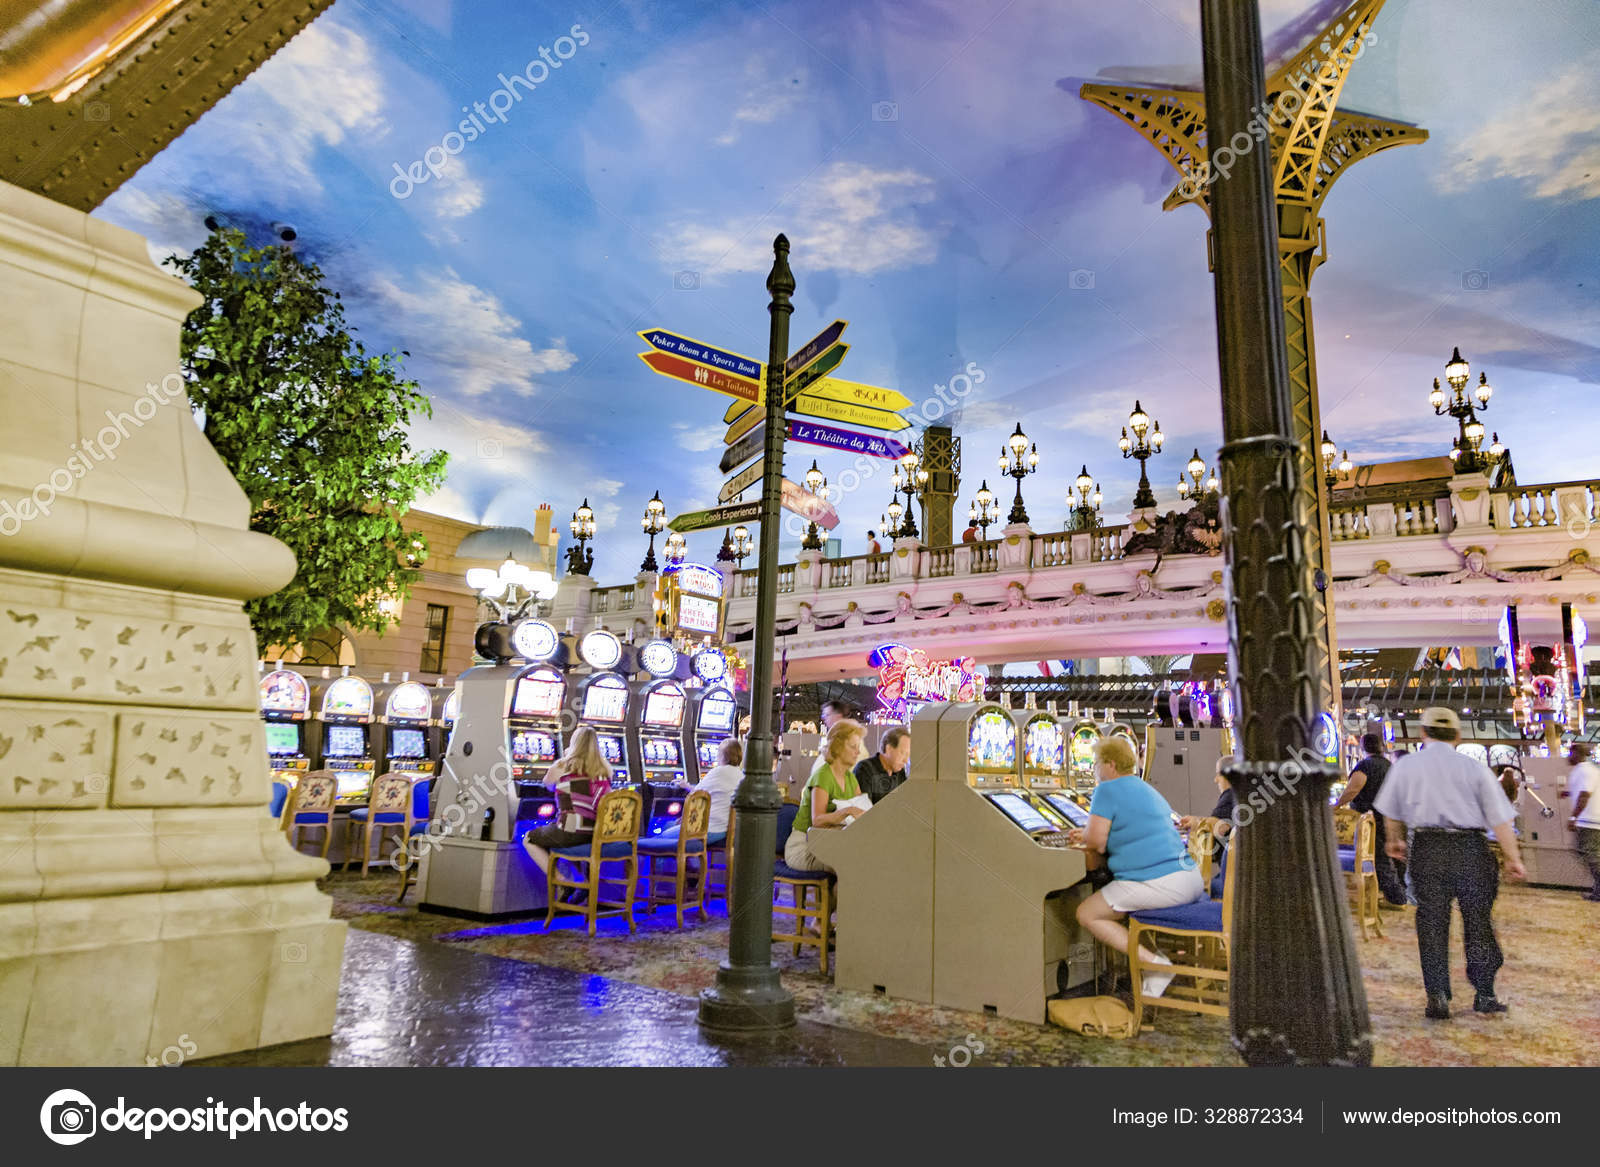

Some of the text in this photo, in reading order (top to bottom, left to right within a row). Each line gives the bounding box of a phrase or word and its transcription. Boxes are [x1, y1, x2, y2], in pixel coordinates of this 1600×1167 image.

[652, 334, 756, 374] Poker Room & Sports Book
[712, 374, 755, 396] Les Toilettes
[802, 399, 889, 423] Eiffel Tower Restaurant
[797, 426, 886, 453] Le Théâtre des Arts
[703, 512, 721, 523] Cools
[722, 506, 757, 520] Experience
